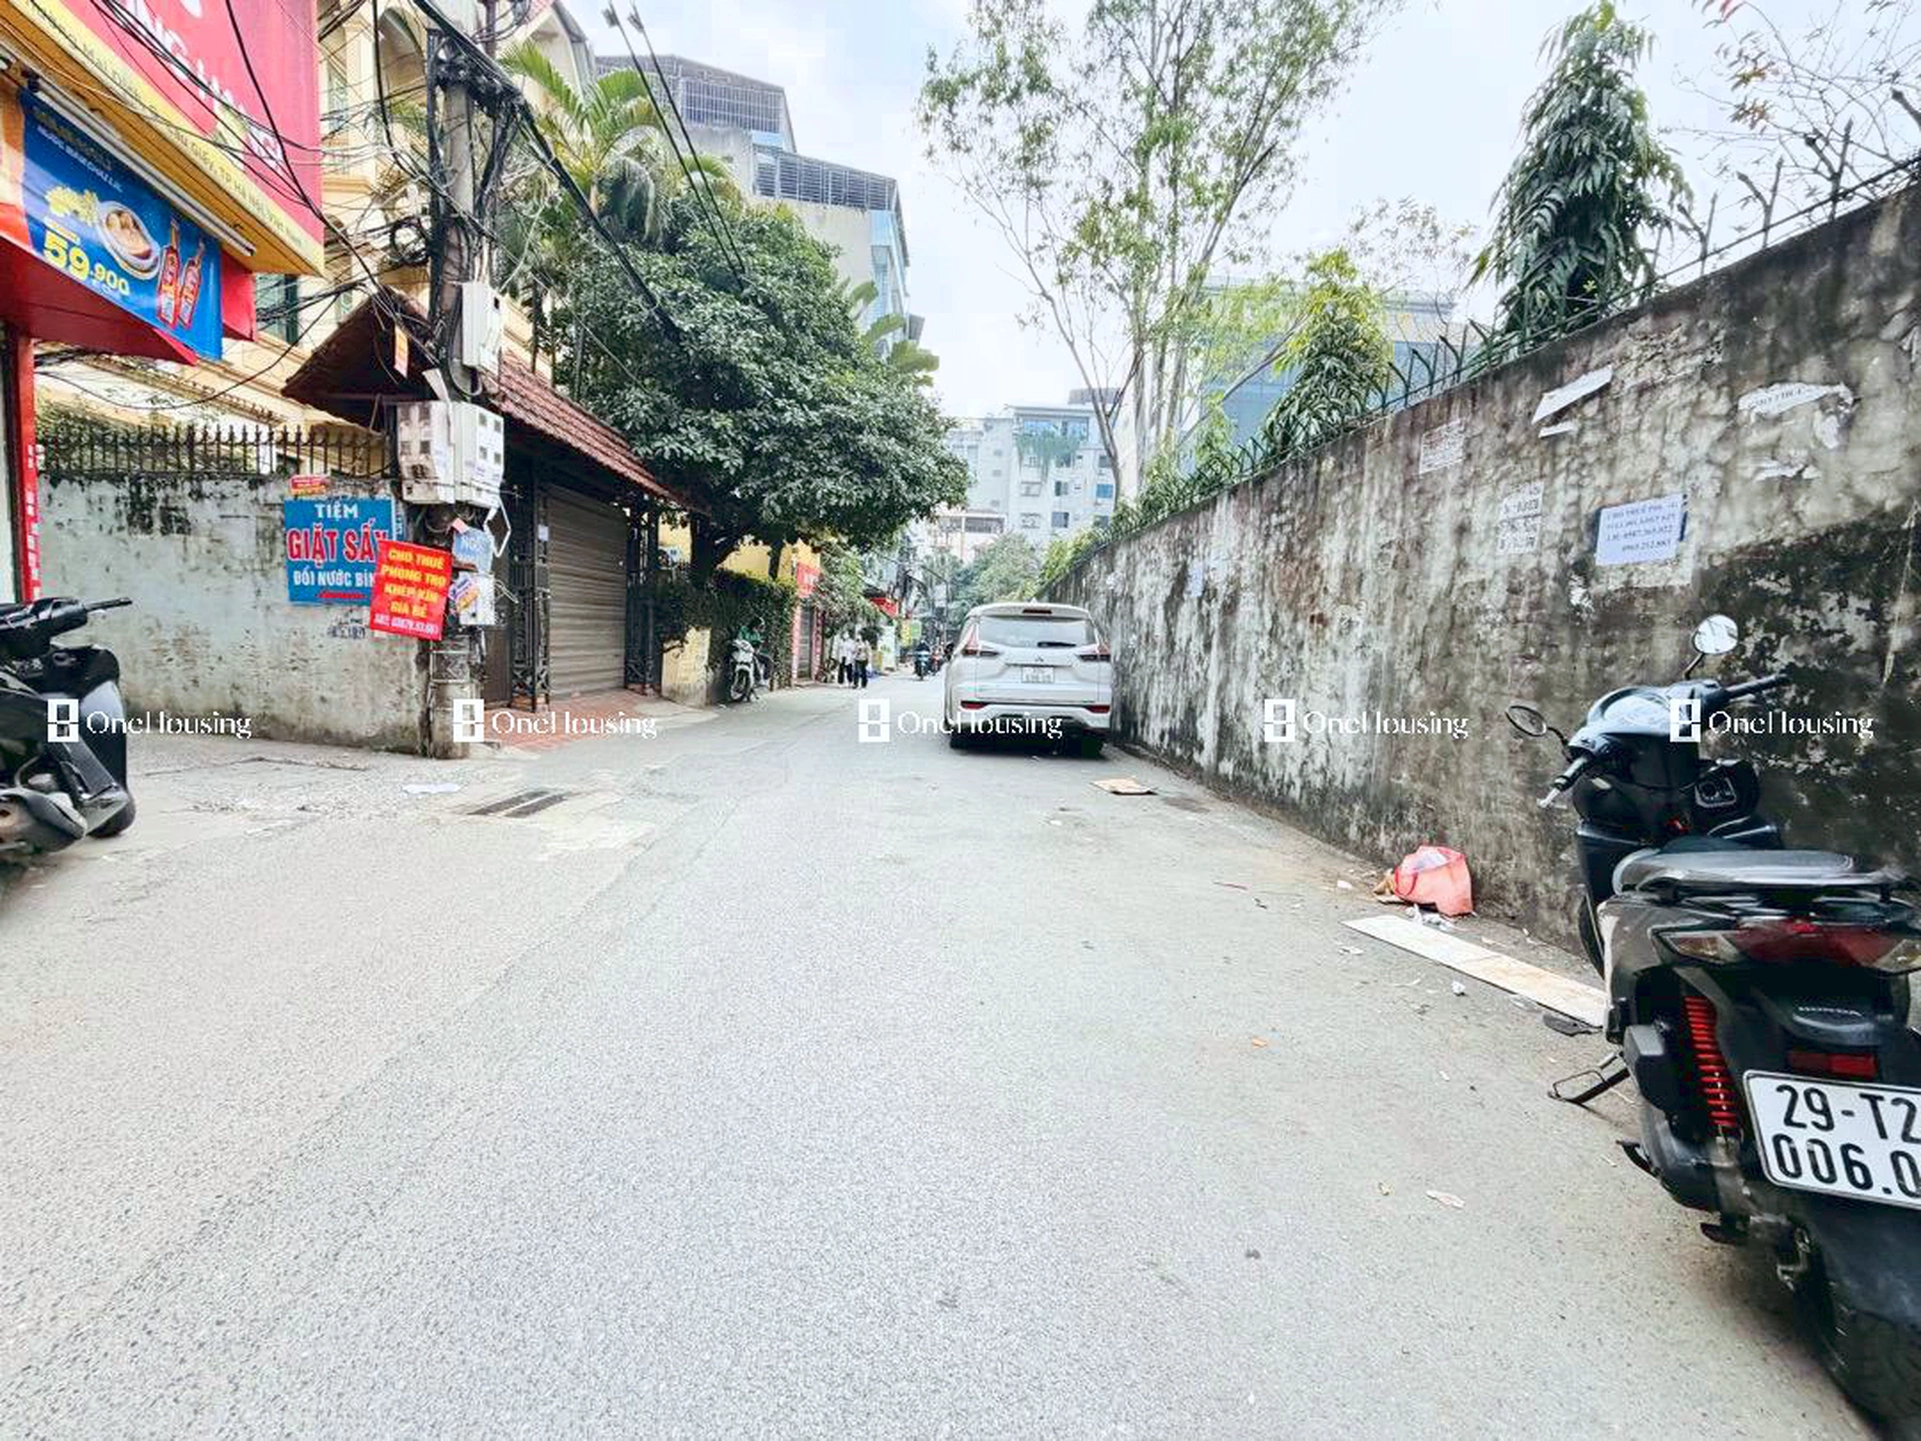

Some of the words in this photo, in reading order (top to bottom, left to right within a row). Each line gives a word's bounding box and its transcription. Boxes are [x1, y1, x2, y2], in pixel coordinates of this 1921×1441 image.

[43, 228, 131, 297] 59.900
[315, 501, 358, 521] TIỆM
[286, 523, 338, 568] GIẶT
[1776, 1084, 1921, 1144] 29-T2
